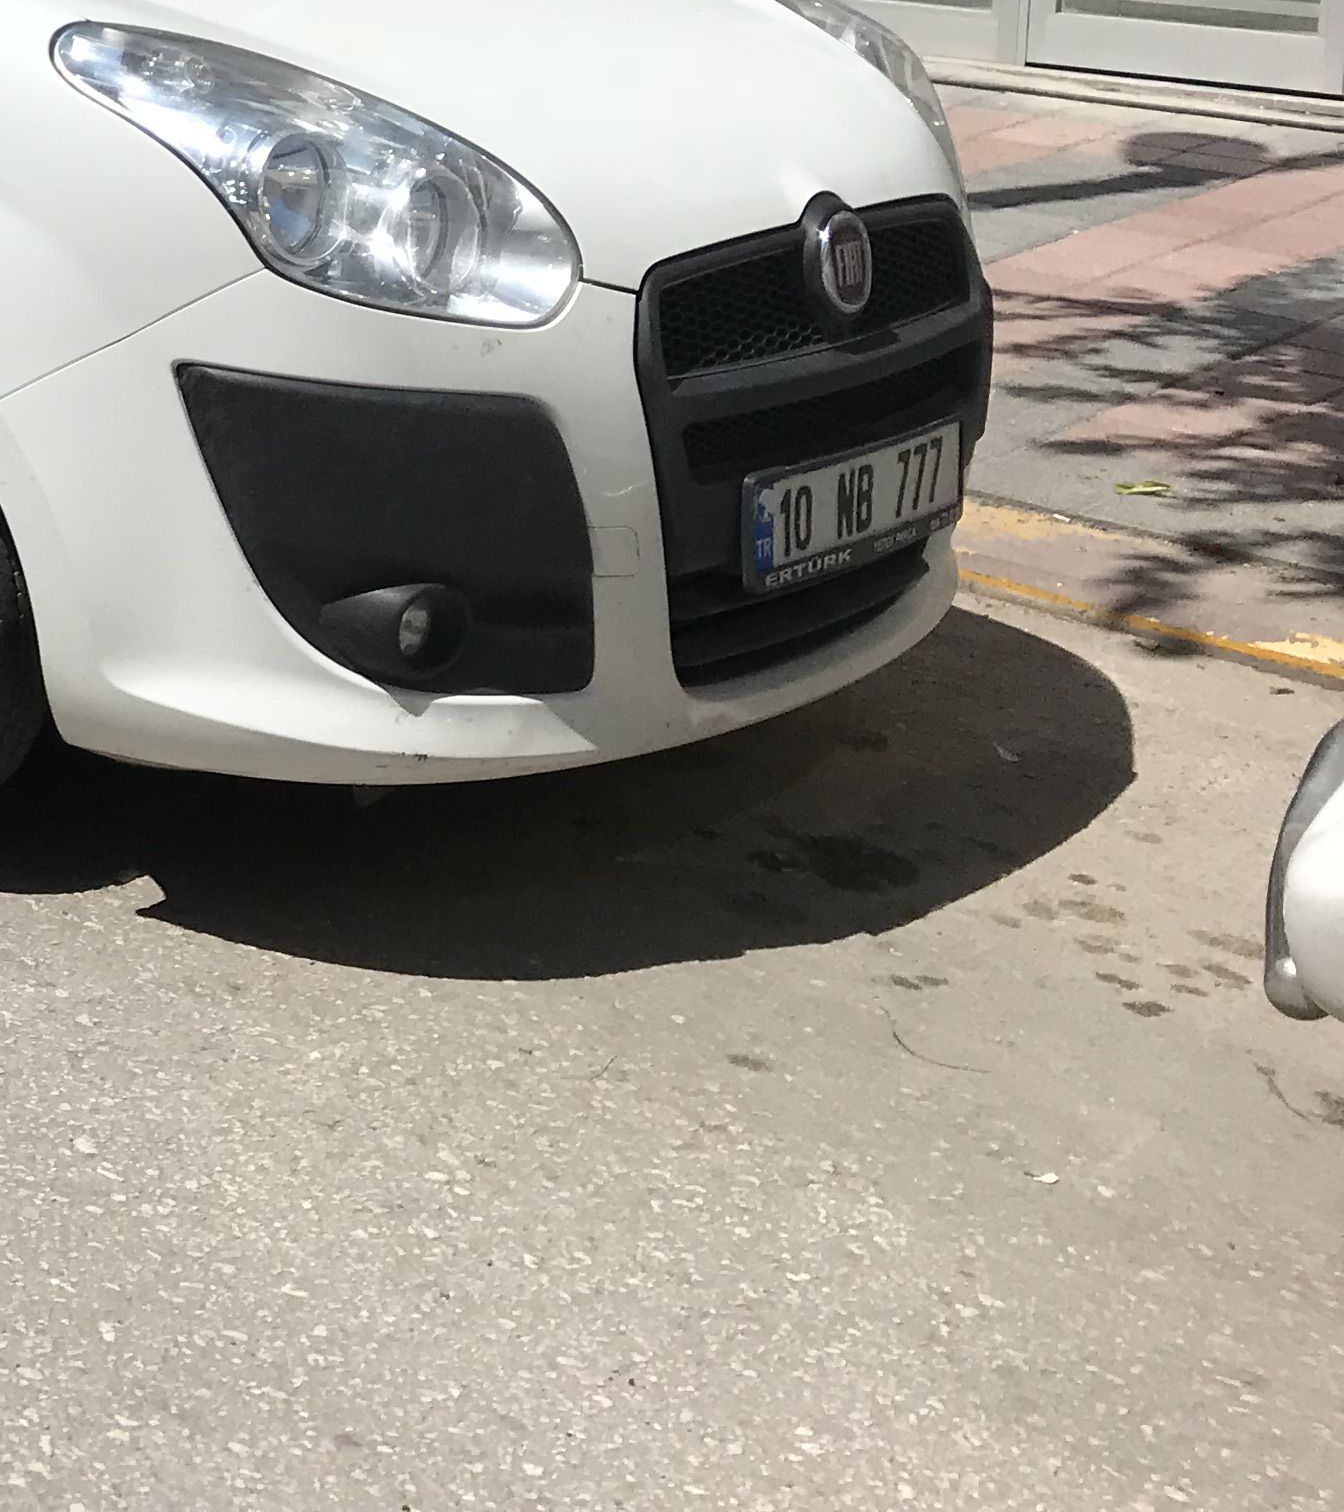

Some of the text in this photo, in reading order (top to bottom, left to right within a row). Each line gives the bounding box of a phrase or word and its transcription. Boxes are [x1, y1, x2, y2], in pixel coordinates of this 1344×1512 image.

[780, 436, 944, 557] 10 NB 777
[755, 537, 772, 561] TR
[765, 548, 852, 588] ERTÜRK
